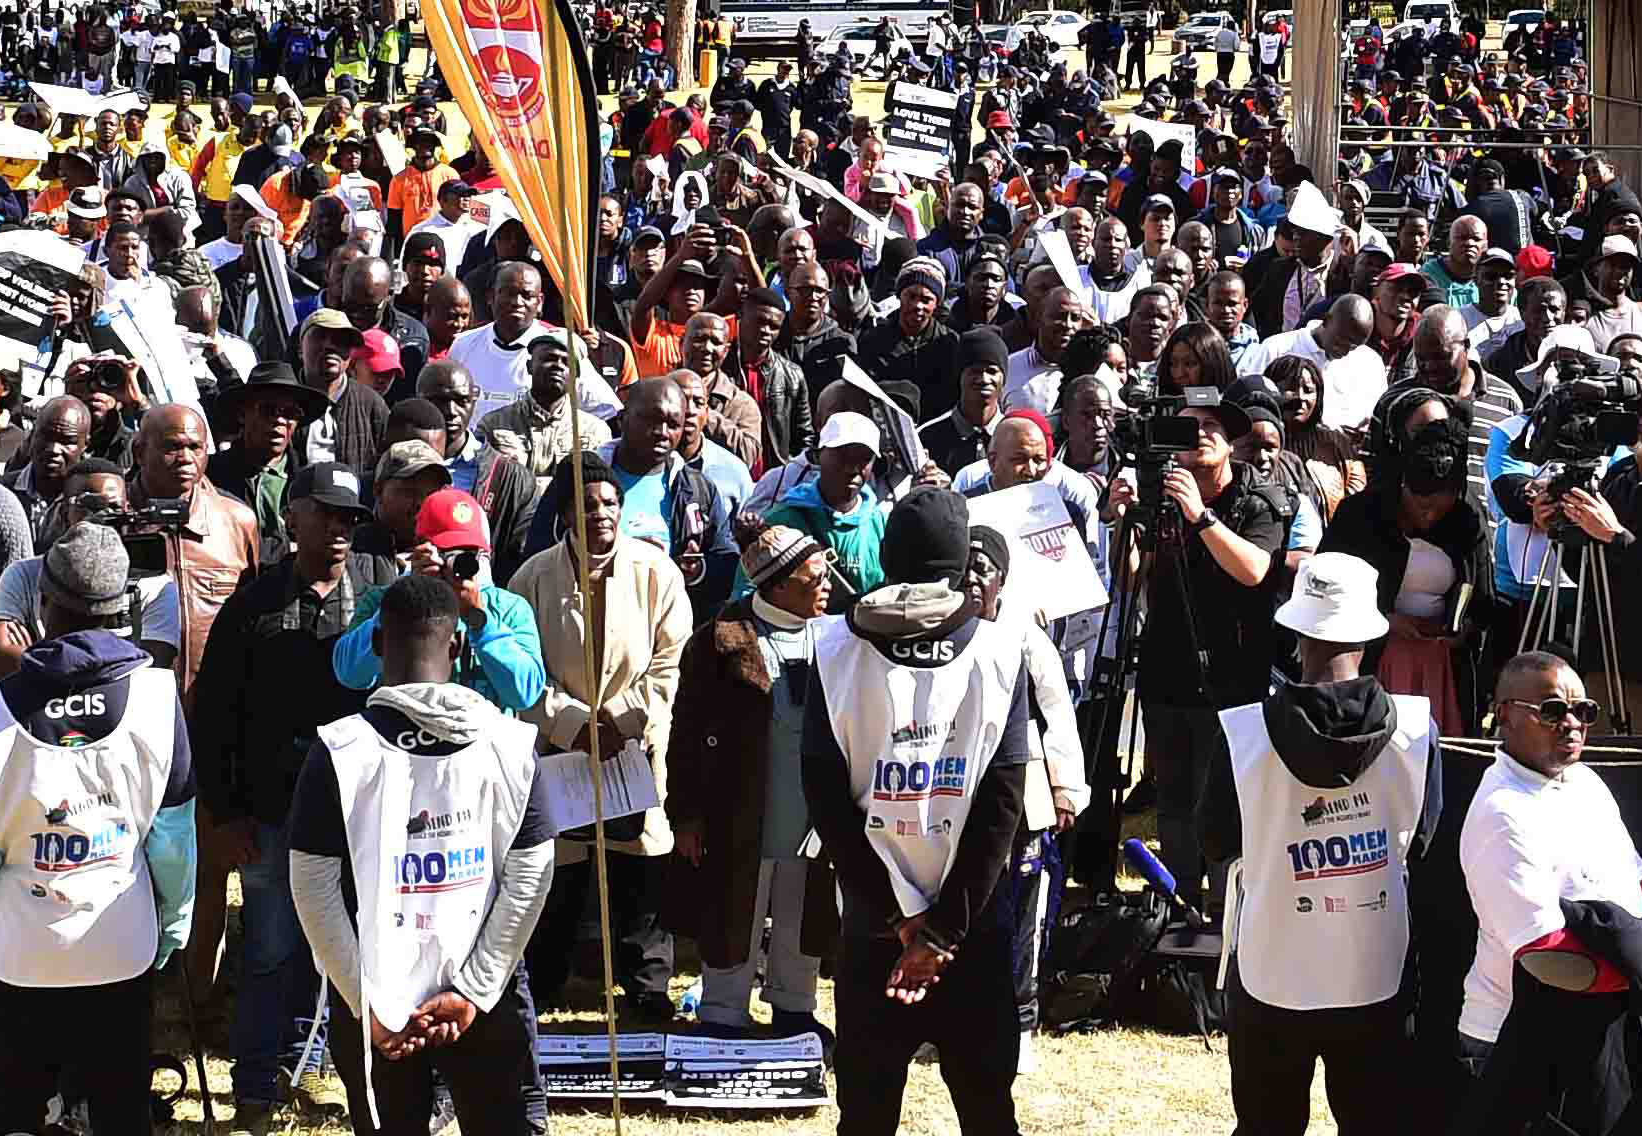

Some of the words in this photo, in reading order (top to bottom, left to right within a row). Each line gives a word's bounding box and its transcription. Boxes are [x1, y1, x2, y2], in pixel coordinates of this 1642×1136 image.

[893, 106, 921, 121] LOVE
[892, 640, 954, 661] GCIS
[44, 693, 106, 719] GCIS
[874, 760, 930, 792] 100
[932, 756, 967, 775] MEN
[30, 831, 90, 864] 100
[1287, 835, 1350, 873] 100
[1349, 828, 1388, 853] MEN
[1352, 847, 1389, 866] MARCH
[394, 851, 446, 885] 100
[447, 846, 485, 869] MEN
[681, 1070, 808, 1081] CHILDREN
[717, 1079, 772, 1089] OUR
